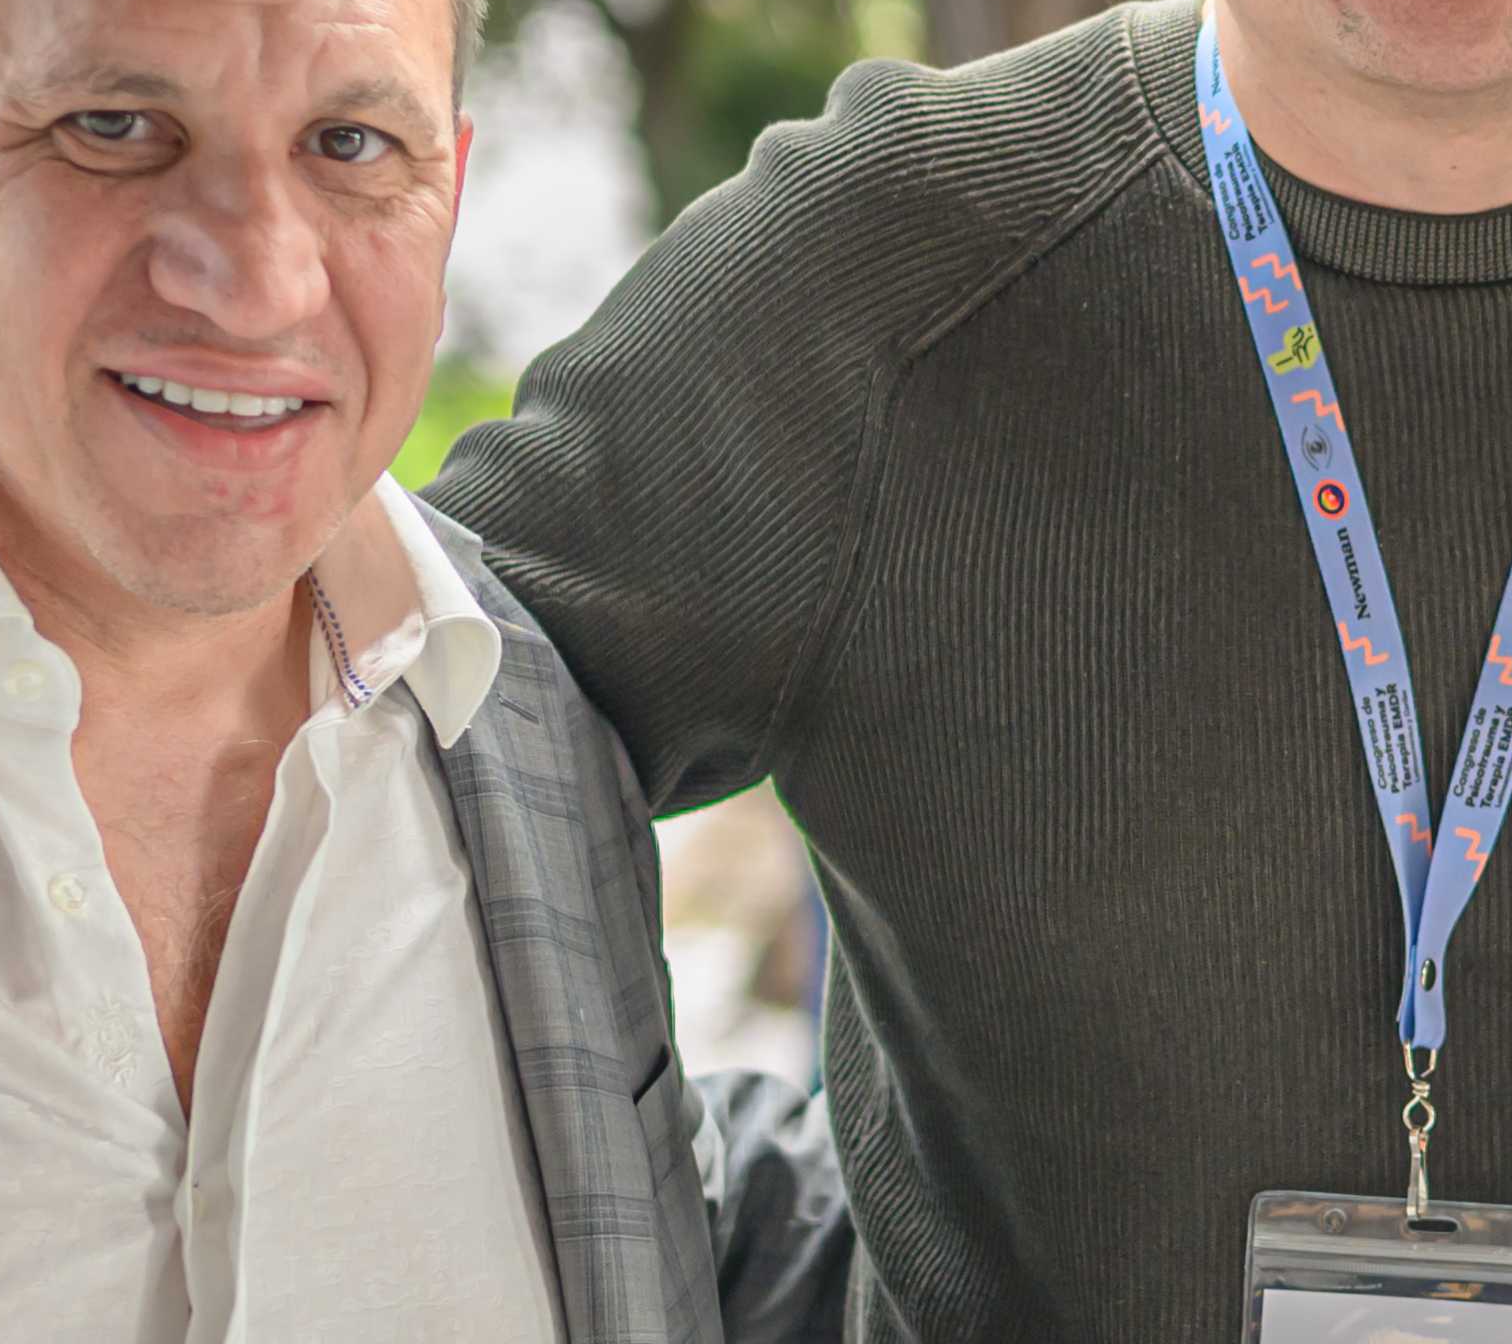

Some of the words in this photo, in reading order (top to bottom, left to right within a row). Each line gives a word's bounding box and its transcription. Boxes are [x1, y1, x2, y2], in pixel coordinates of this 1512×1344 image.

[1336, 527, 1372, 621] Newman
[1361, 696, 1373, 715] de
[1386, 683, 1404, 730] EMDR
[1367, 719, 1387, 790] Congreso
[1377, 700, 1401, 794] Psicotrauma
[1397, 734, 1413, 790] Terapia
[1453, 729, 1481, 797] Congreso
[1473, 707, 1487, 726] de
[1465, 718, 1500, 808] Psicotrauma
[1480, 756, 1506, 808] Terapia
